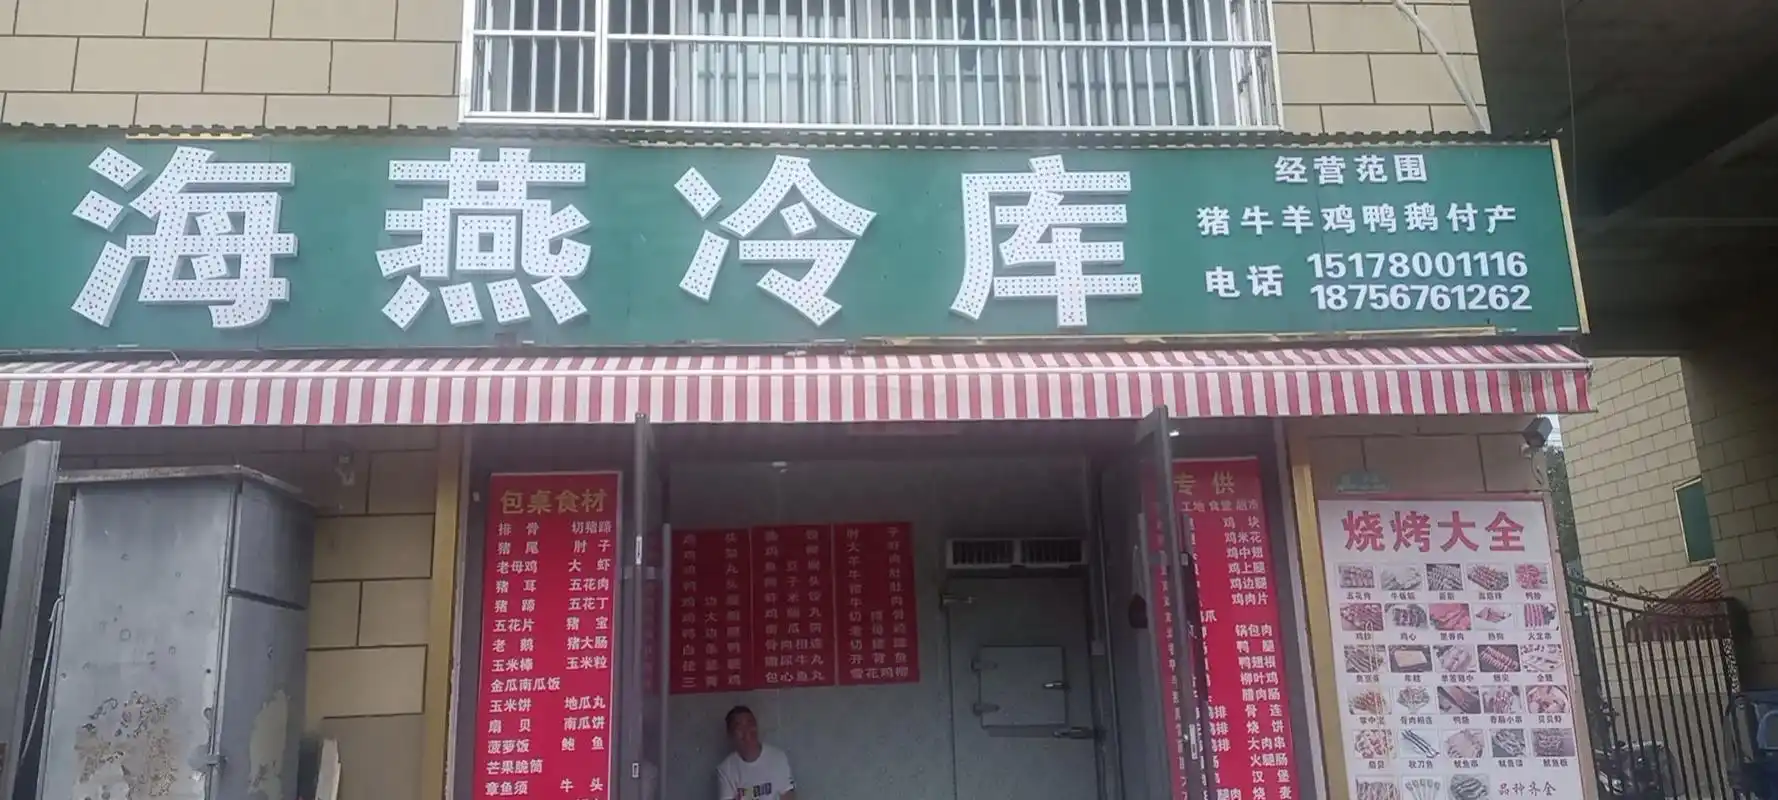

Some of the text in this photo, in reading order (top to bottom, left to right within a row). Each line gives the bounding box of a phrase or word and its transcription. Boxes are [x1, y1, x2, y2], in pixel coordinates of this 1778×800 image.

[1274, 154, 1428, 185] 经营范围
[1197, 202, 1516, 236] 猪牛羊鸡鸭鹅付产
[71, 146, 1143, 331] 海燕冷库
[1205, 252, 1528, 298] 电话 15178001116
[1310, 284, 1532, 311] 18756761262
[1173, 471, 1235, 495] 专供
[500, 489, 608, 515] 包桌食材
[1181, 501, 1205, 512] 工地
[498, 522, 540, 536] 排骨
[1223, 516, 1260, 529] 鸡块
[1224, 531, 1262, 544] 鸡米花
[1341, 510, 1525, 552] 烧烤大全
[497, 541, 539, 555] 猪尾
[573, 539, 611, 553] 肘子
[1226, 547, 1264, 559] 鸡中翅
[496, 560, 538, 574] 老母鸡
[568, 558, 611, 572] 大虾
[1228, 561, 1265, 574] 鸡上腿
[496, 580, 537, 593] 猪耳
[569, 578, 609, 591] 五花肉
[1230, 577, 1267, 590] 鸡边腿
[494, 599, 535, 613] 猪蹄
[568, 597, 609, 610] 五花丁
[1232, 593, 1268, 606] 鸡肉片
[493, 618, 535, 633] 五花片
[1235, 624, 1272, 638] 锅包肉
[492, 638, 534, 652] 老鹅
[567, 636, 608, 650] 猪大肠
[1237, 639, 1275, 653] 鸭腿
[491, 658, 533, 672] 玉米棒
[566, 656, 608, 670] 玉米粒
[1238, 656, 1276, 670] 鸭翅根
[491, 677, 560, 693] 金瓜南瓜饭
[1240, 672, 1278, 686] 柳叶鸡
[489, 698, 532, 713] 玉米饼
[564, 696, 606, 710] 地瓜丸
[488, 719, 531, 733] 扇贝
[564, 716, 605, 730] 南瓜饼
[1246, 720, 1284, 734] 烧饼
[488, 739, 530, 754] 菠萝饭
[561, 736, 604, 751] 鲍鱼
[1248, 737, 1285, 750] 大肉串
[486, 759, 543, 774] 芒果脆筒
[1250, 752, 1288, 767] 火腿肠
[1252, 769, 1290, 783] 汉堡
[485, 781, 528, 796] 章鱼须
[560, 777, 603, 792] 牛头
[1498, 781, 1557, 797] 品种齐全
